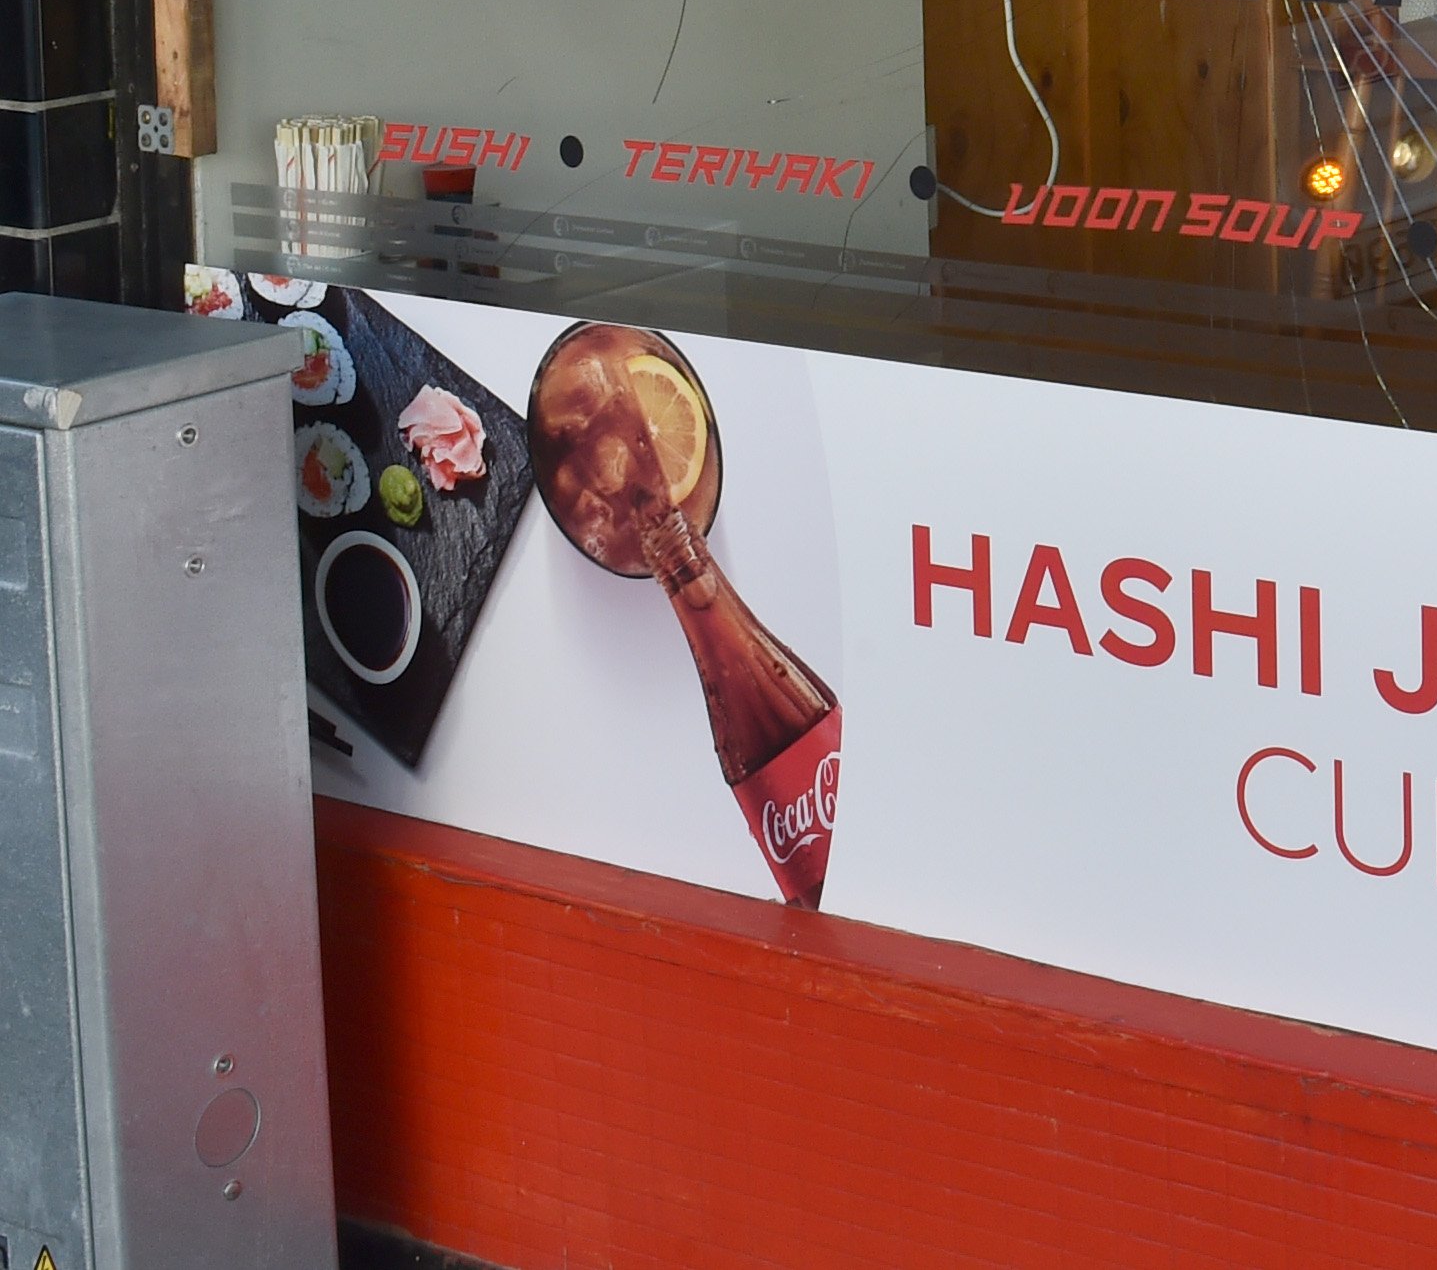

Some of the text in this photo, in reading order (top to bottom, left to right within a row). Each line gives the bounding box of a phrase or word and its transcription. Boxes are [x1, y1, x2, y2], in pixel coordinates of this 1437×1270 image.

[378, 122, 531, 171] SUSHI
[622, 139, 874, 200] TERIYAKI
[1179, 193, 1362, 250] SOUP
[911, 523, 1322, 698] HASHI
